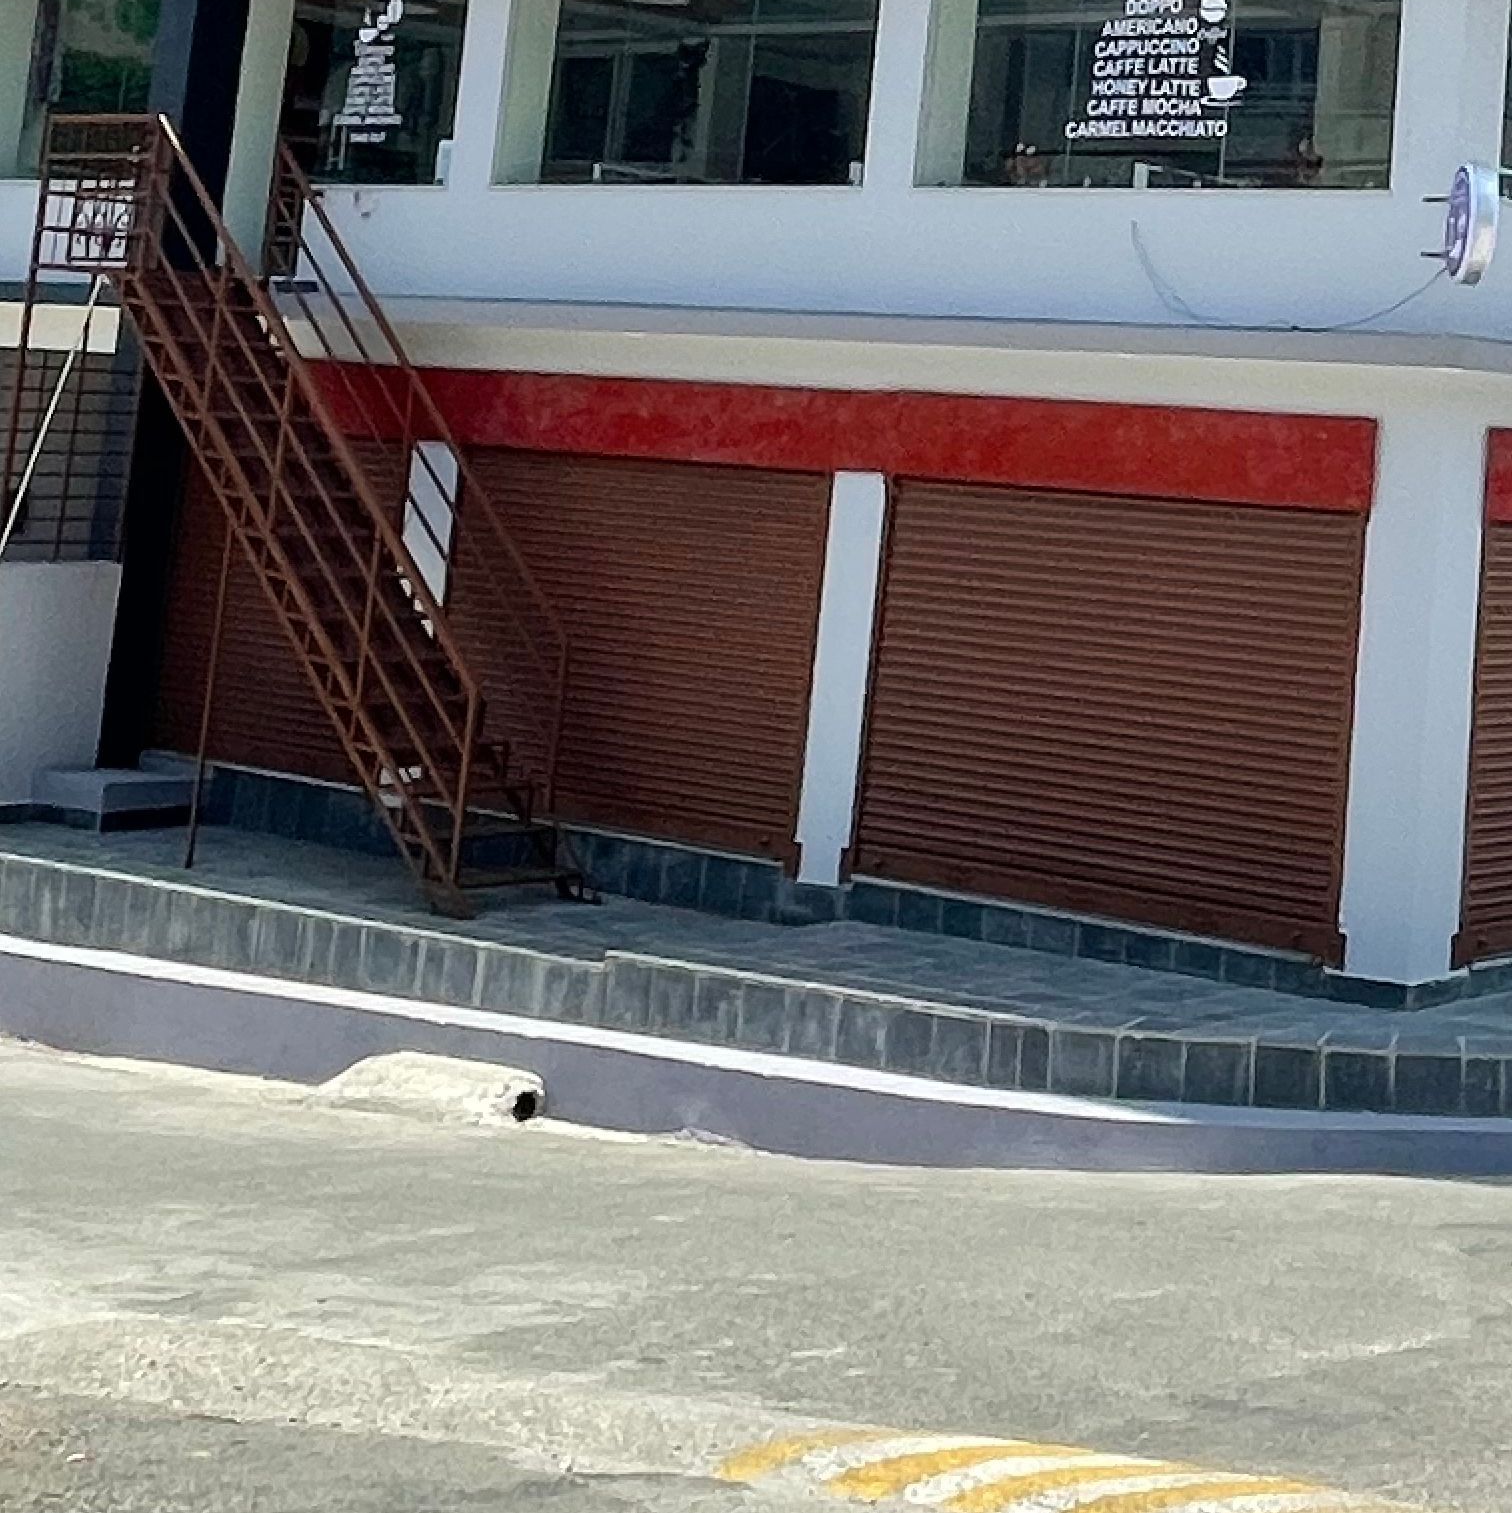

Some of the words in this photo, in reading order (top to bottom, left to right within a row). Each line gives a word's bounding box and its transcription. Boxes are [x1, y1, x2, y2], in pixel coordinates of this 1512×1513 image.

[1101, 17, 1198, 37] AMERICANO
[1094, 38, 1200, 58] CAPPUCCINO
[1092, 58, 1146, 77] CAFFE
[1148, 57, 1200, 75] LATTE
[1092, 78, 1149, 96] HONEY
[1150, 78, 1201, 97] LATTE
[1087, 99, 1138, 116] CAFFE
[1141, 98, 1202, 116] MOCHA
